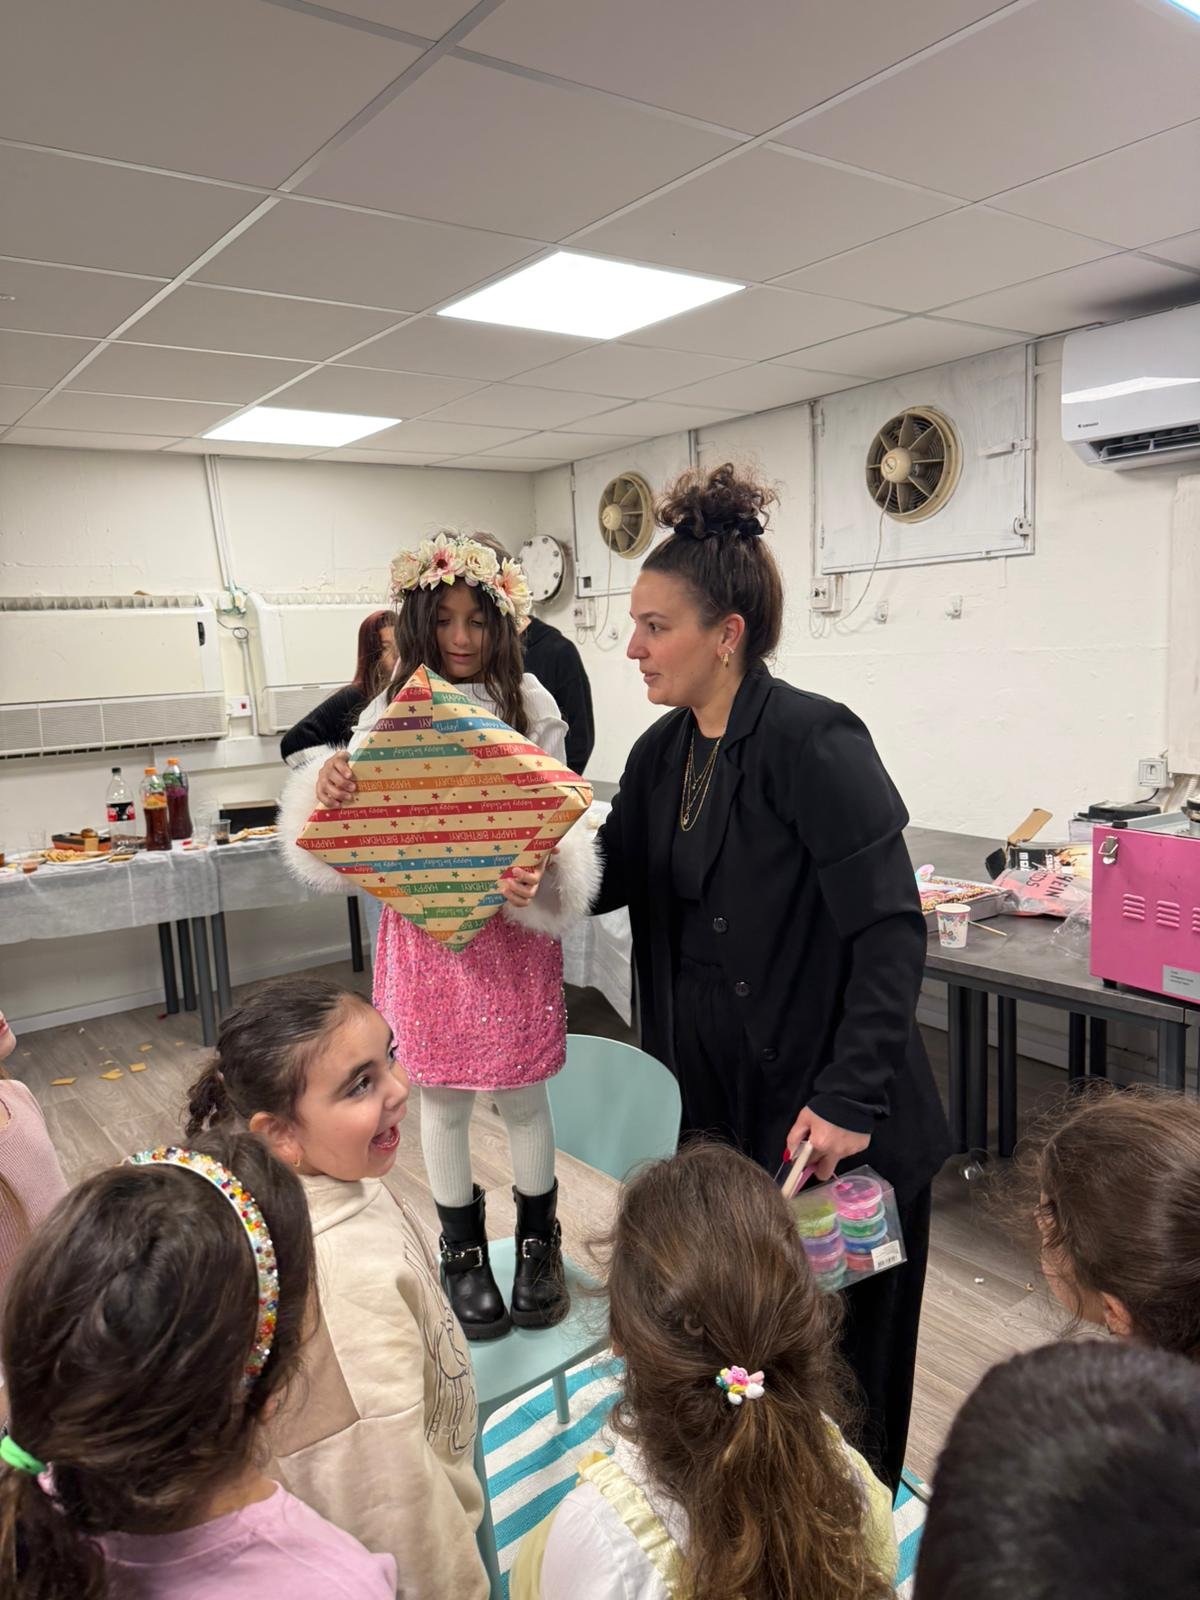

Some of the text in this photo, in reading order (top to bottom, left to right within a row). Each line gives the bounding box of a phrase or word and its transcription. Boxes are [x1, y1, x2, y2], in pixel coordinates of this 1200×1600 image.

[359, 833, 426, 847] HAPPY BIRTHDAY!
[448, 829, 517, 842] HAPPY BIRTHDAY!
[310, 838, 336, 850] HAPPY
[413, 884, 439, 895] HAPPY
